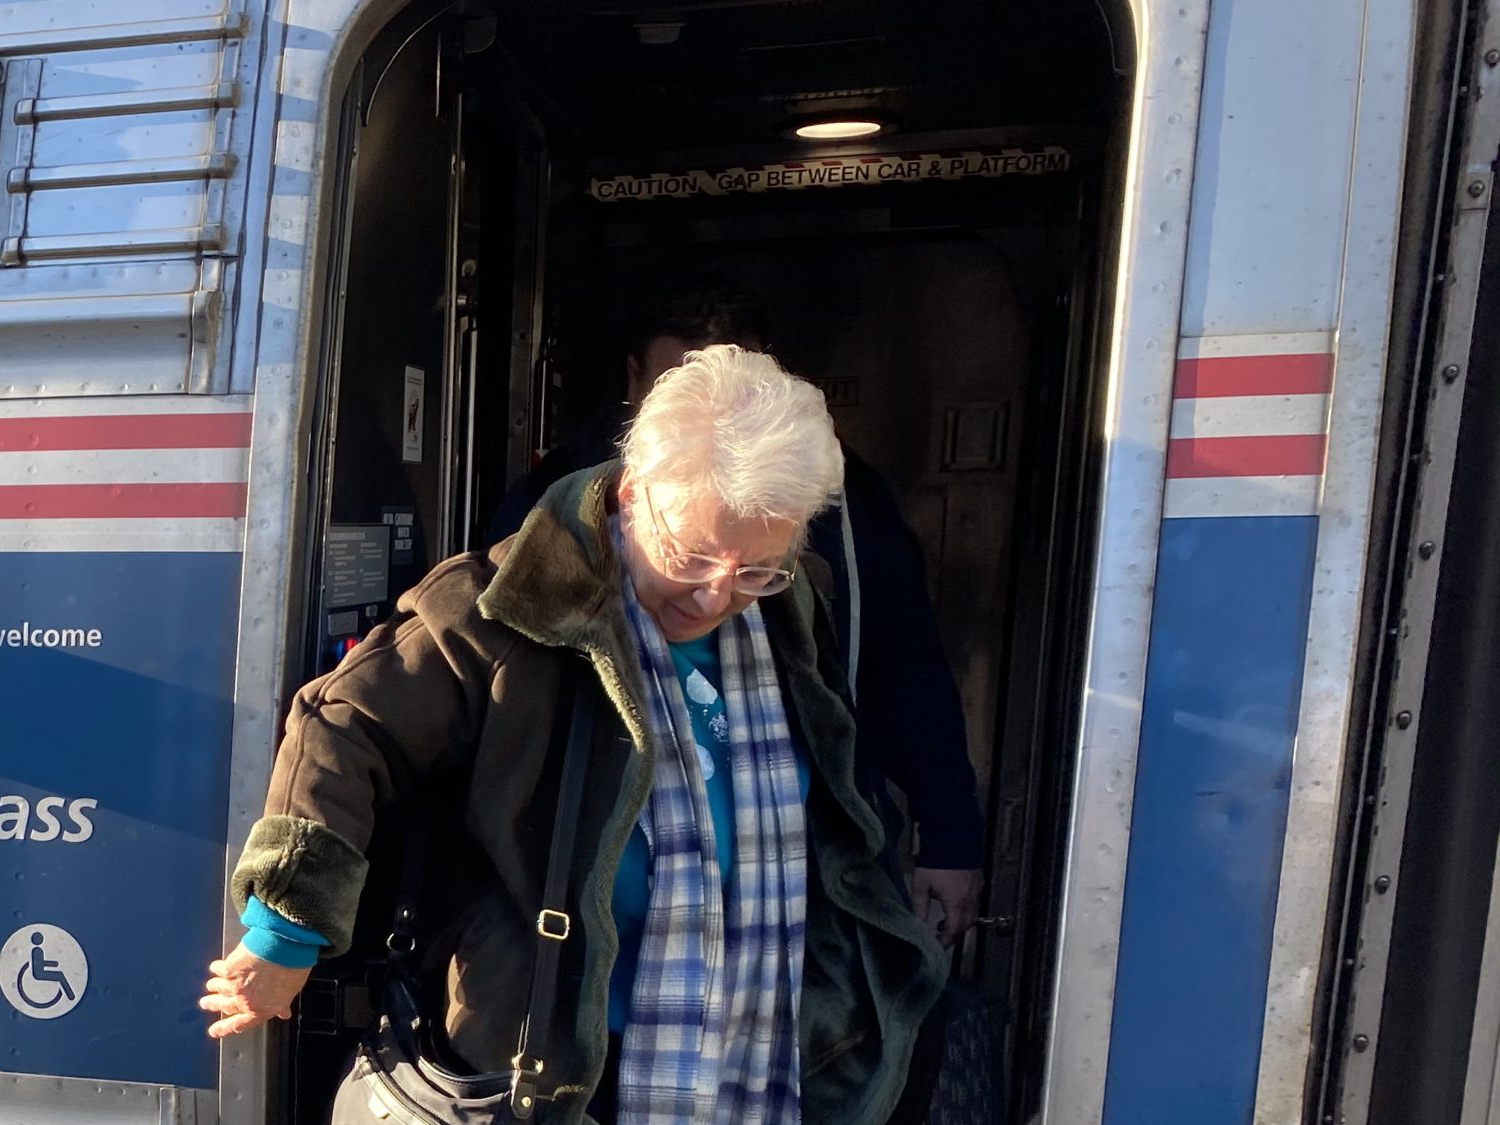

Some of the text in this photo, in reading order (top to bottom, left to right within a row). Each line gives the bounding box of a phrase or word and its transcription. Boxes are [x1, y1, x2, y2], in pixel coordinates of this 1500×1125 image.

[598, 153, 1067, 197] CAUTION GAP BETWEEN CAR & PLATFORM
